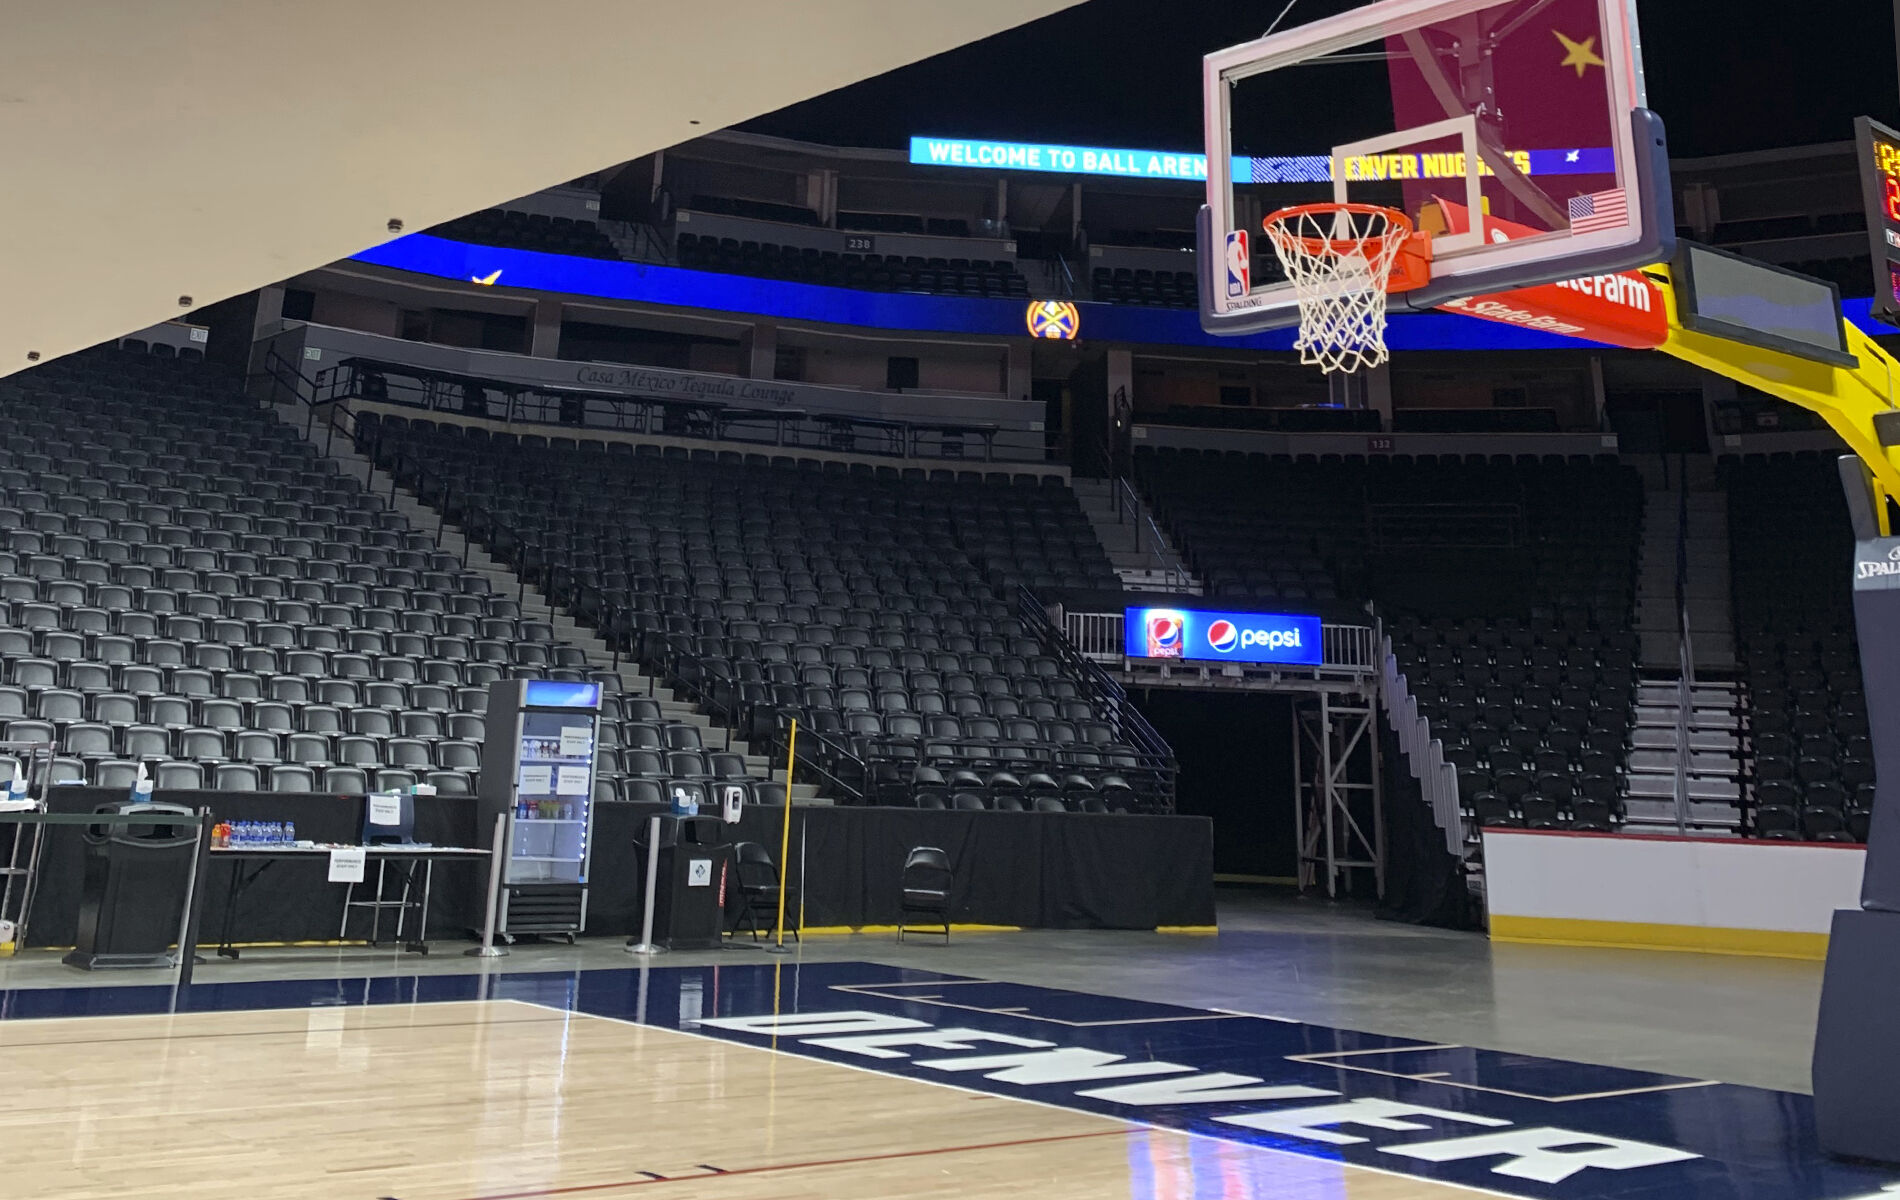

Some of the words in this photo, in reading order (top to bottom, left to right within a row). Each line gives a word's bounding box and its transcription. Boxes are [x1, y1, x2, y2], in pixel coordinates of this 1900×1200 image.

[928, 142, 1041, 167] WELCOME
[1049, 149, 1076, 169] TO
[1083, 151, 1141, 173] BALL
[1147, 155, 1208, 177] AREN
[849, 239, 871, 249] 238
[1226, 297, 1263, 312] SPALDING
[577, 366, 614, 385] Casa
[680, 376, 735, 399] Tequila
[741, 383, 796, 407] Lounge
[1857, 561, 1900, 580] SPAL
[1240, 628, 1302, 651] pepsi
[1153, 647, 1180, 657] pepsi
[698, 1010, 1702, 1184] DENVER
